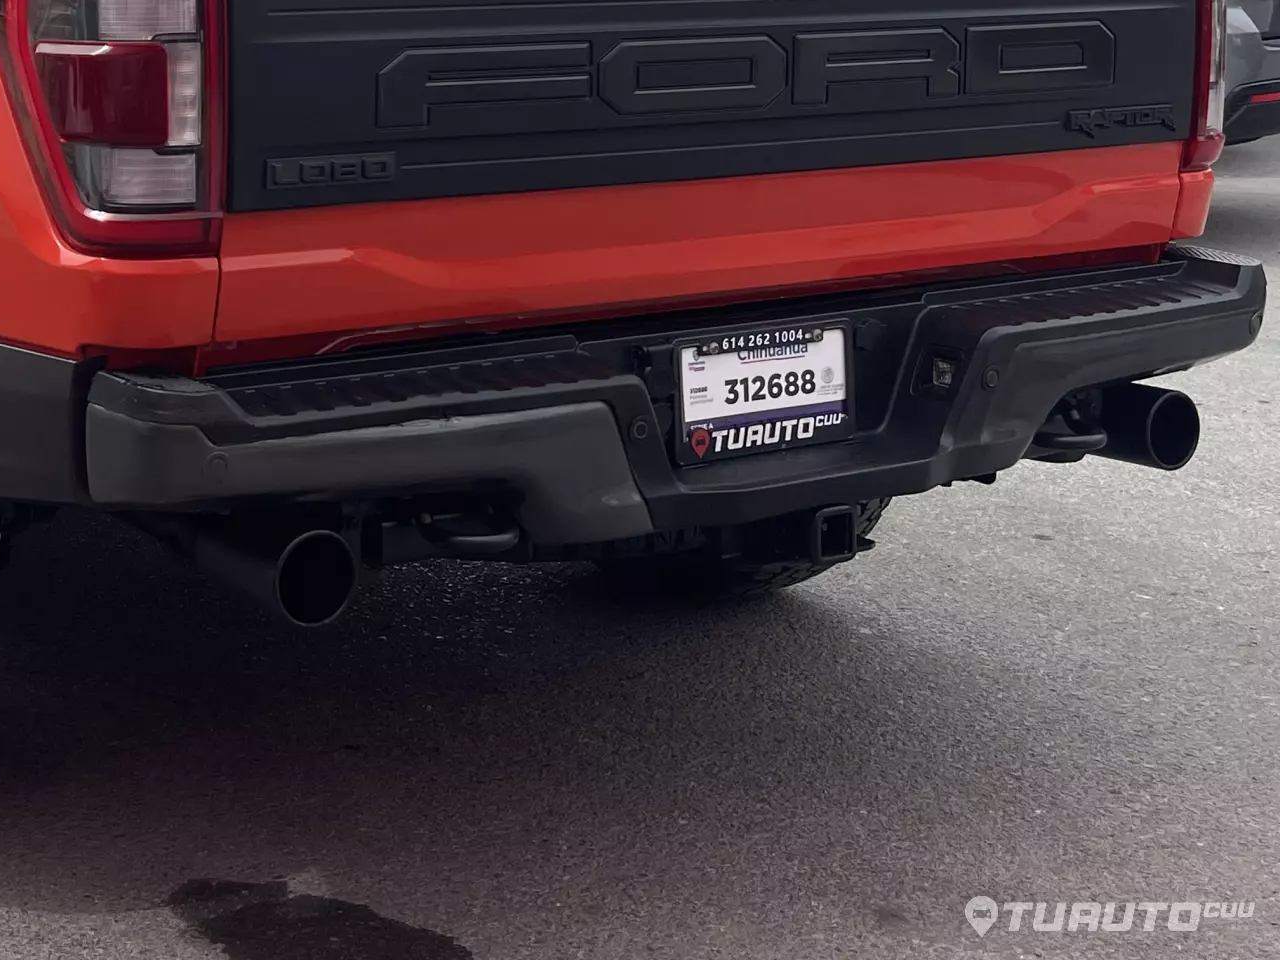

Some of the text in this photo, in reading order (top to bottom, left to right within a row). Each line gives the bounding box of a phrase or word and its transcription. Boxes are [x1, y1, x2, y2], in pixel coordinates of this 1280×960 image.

[375, 20, 1115, 128] FORD
[1065, 103, 1176, 139] RAPTOR
[269, 156, 393, 187] LOBO
[722, 328, 804, 350] 614 262 1004
[724, 369, 816, 404] 312688
